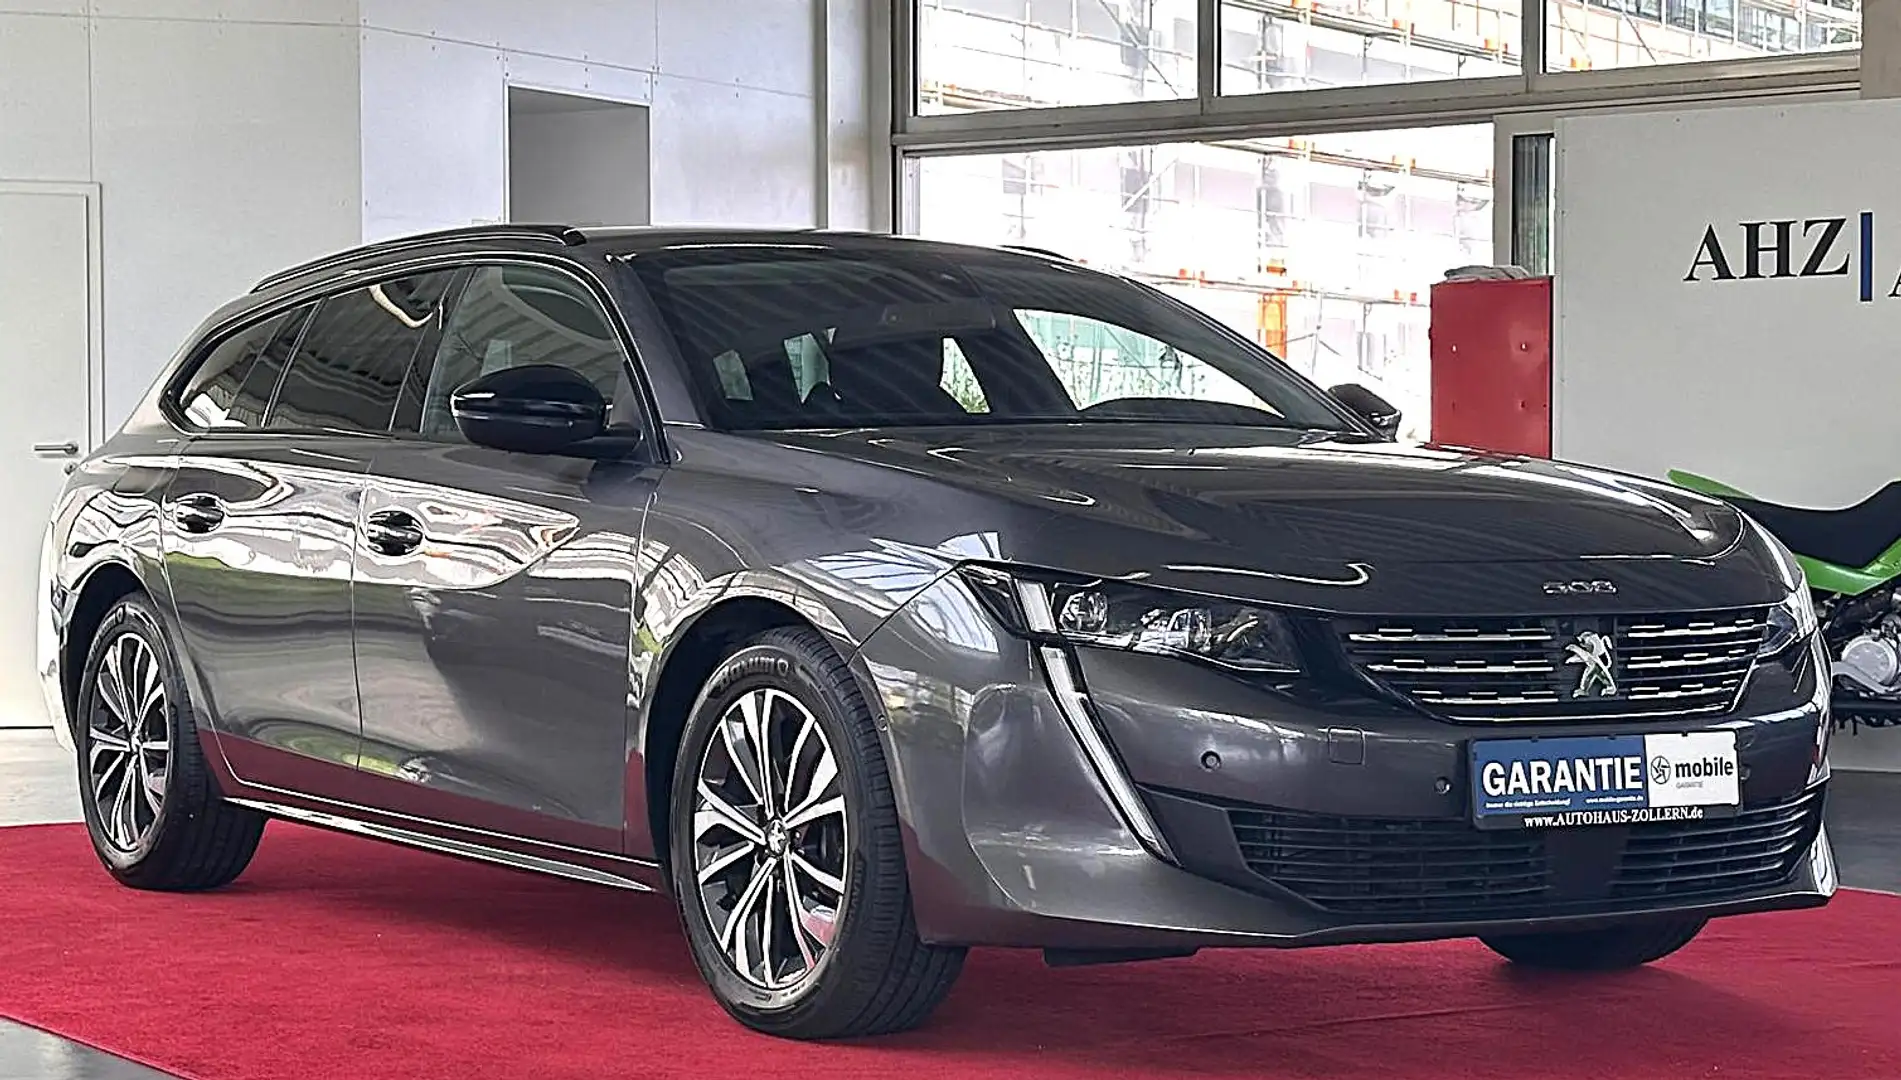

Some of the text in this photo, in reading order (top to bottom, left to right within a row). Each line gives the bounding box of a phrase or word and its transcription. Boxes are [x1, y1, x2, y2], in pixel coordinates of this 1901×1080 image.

[1682, 217, 1851, 282] AHZ
[1482, 756, 1643, 796] GARANTIE
[1674, 756, 1735, 778] mobile
[1524, 806, 1704, 828] www.AUTOHAUS-ZOLLERN.de
